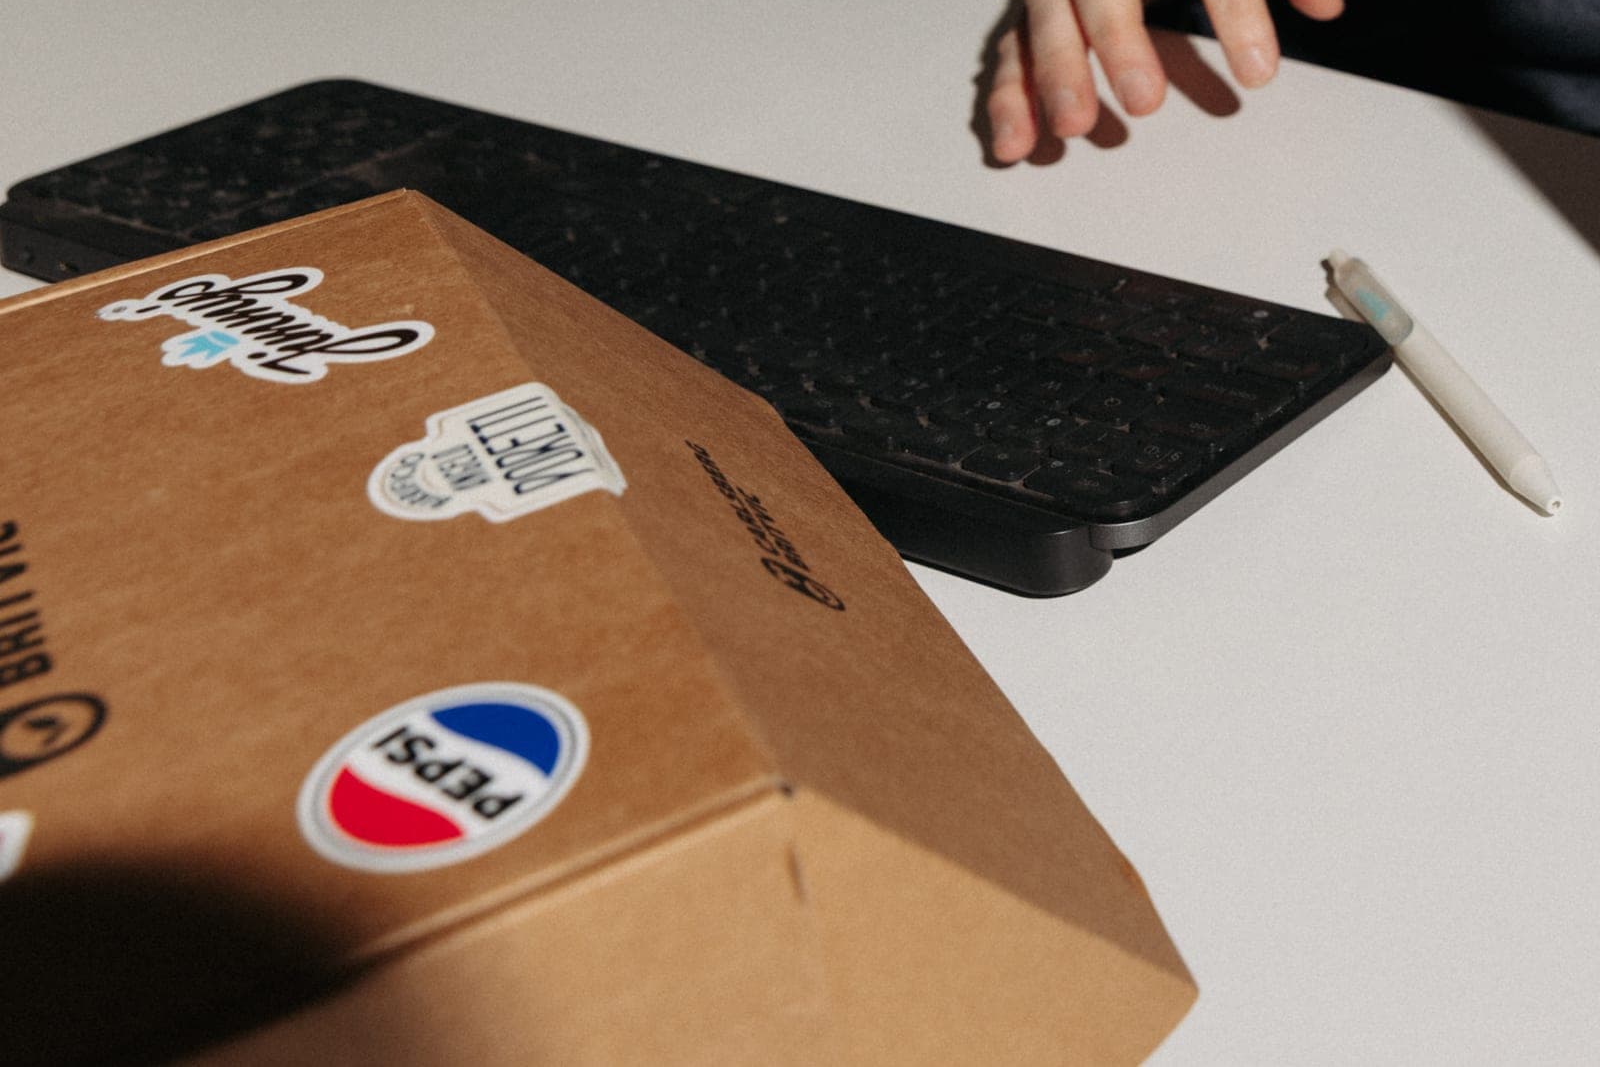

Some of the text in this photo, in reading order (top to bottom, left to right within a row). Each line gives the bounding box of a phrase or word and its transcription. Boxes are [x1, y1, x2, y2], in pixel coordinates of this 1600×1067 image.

[134, 273, 420, 376] Jimmy's
[465, 395, 596, 496] PORETTI
[372, 726, 524, 820] PEPSI
